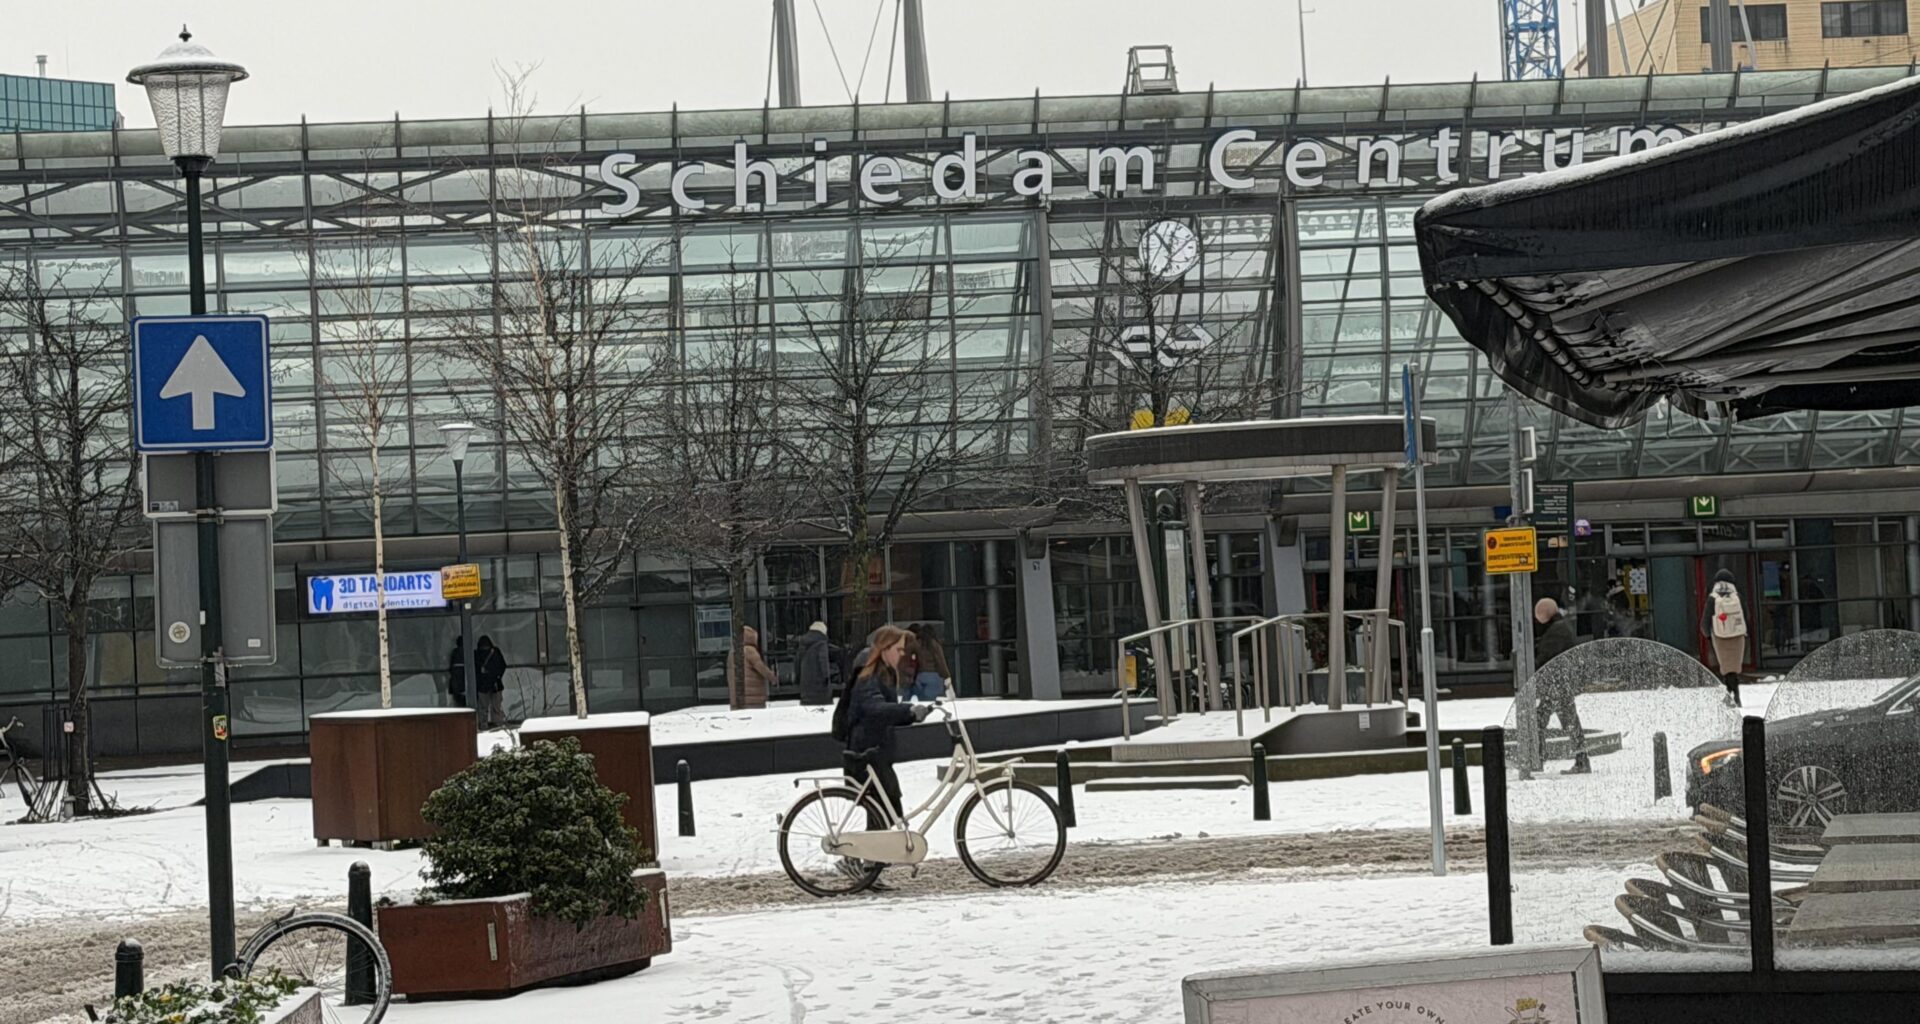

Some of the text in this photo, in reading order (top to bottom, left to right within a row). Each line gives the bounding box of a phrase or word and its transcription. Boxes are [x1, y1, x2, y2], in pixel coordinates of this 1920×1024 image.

[599, 132, 1155, 214] Schiedam
[338, 577, 357, 593] 3D
[343, 598, 431, 610] digital dentistry
[1376, 1001, 1411, 1010] YOUR
[1416, 1006, 1445, 1024] OWN
